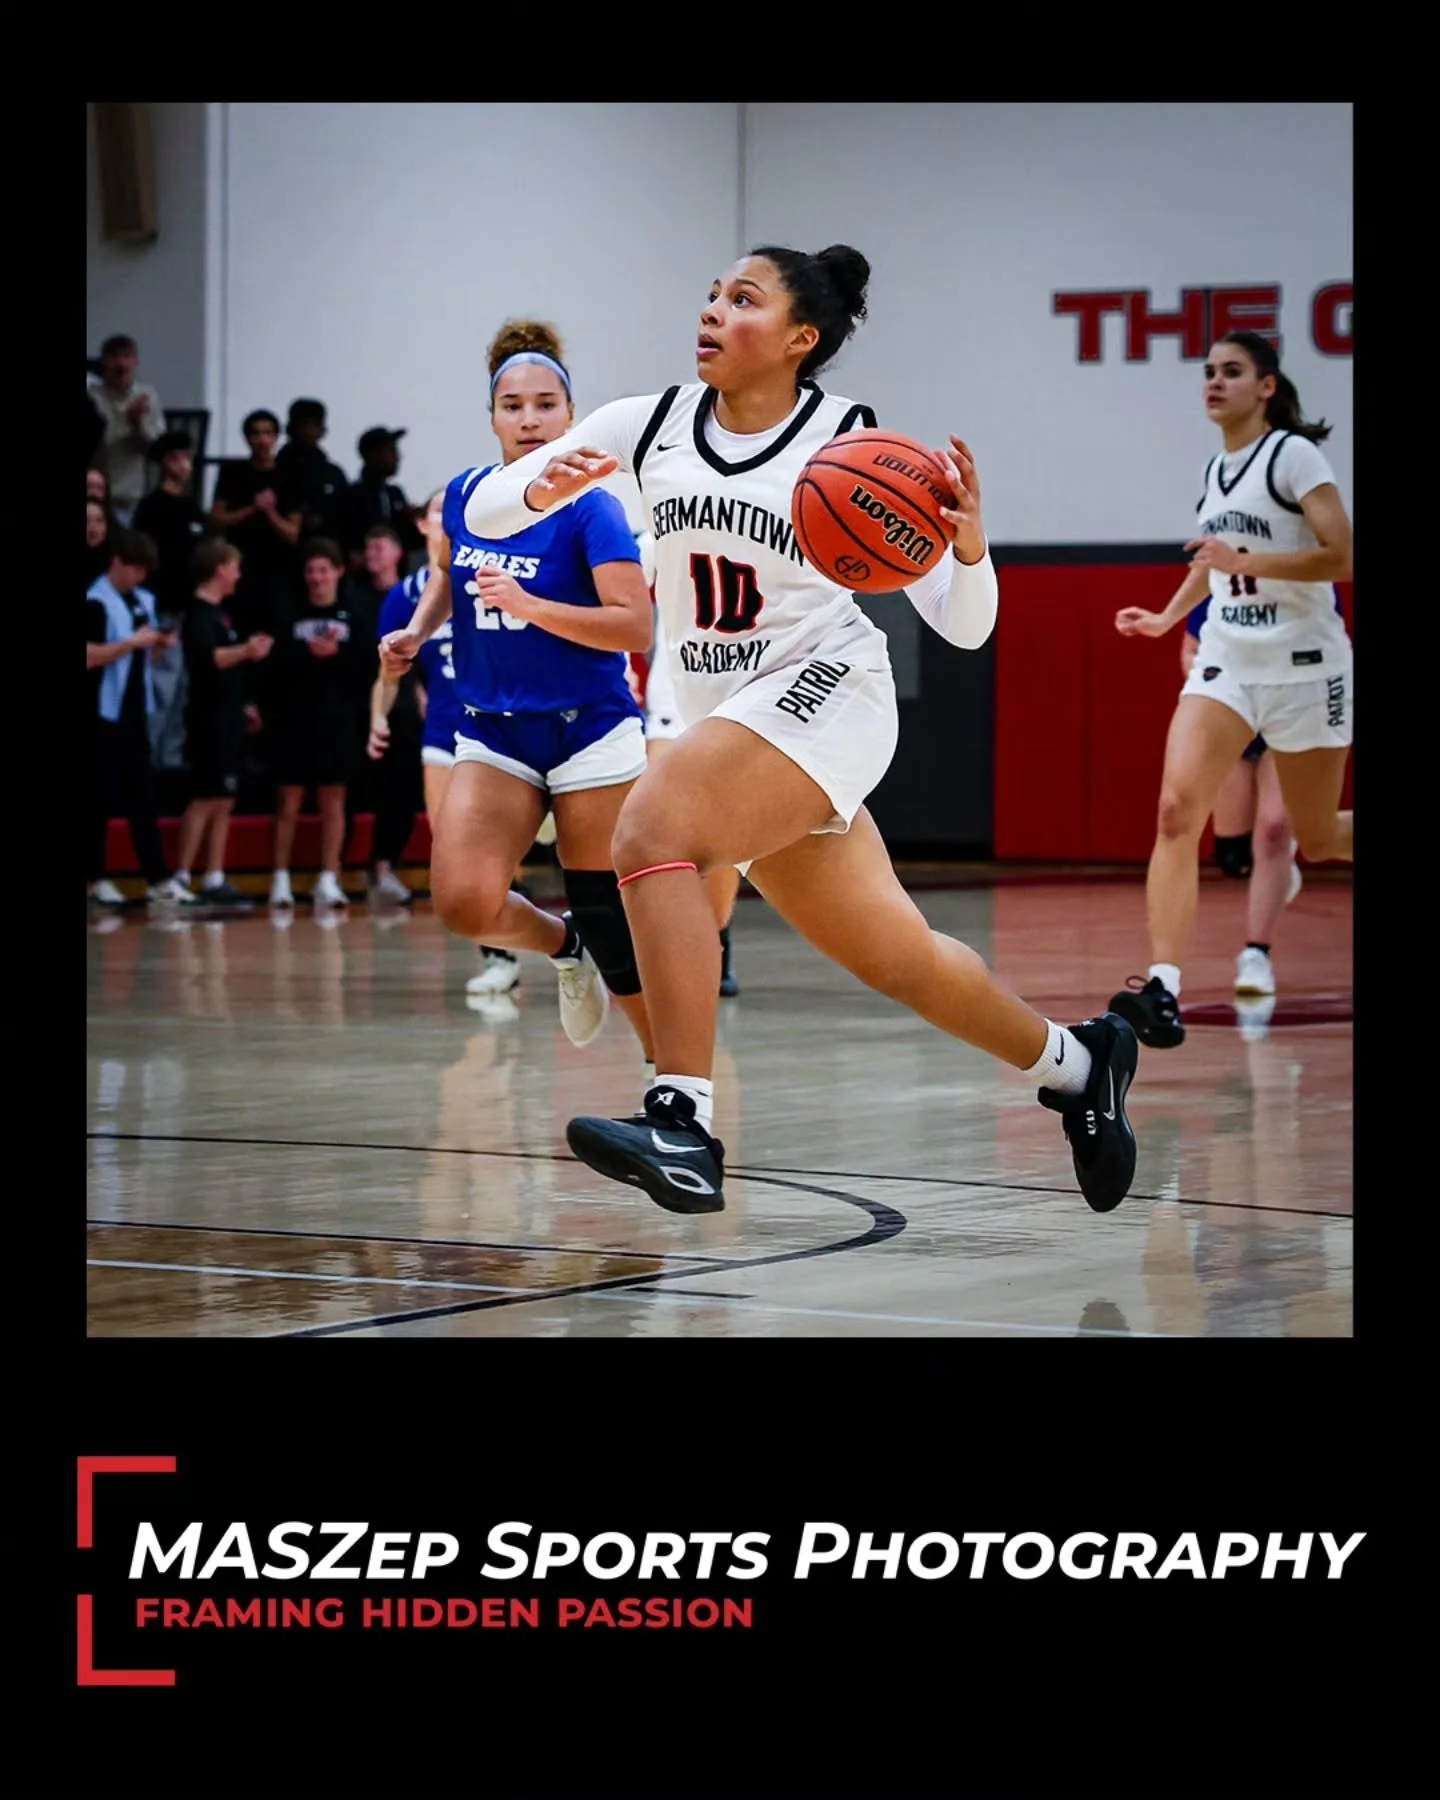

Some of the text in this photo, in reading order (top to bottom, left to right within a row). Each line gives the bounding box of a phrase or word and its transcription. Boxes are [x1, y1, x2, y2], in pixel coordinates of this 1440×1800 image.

[1053, 283, 1281, 363] THE
[453, 544, 541, 579] EAGLES
[849, 484, 936, 566] Wilson
[690, 552, 765, 634] 10
